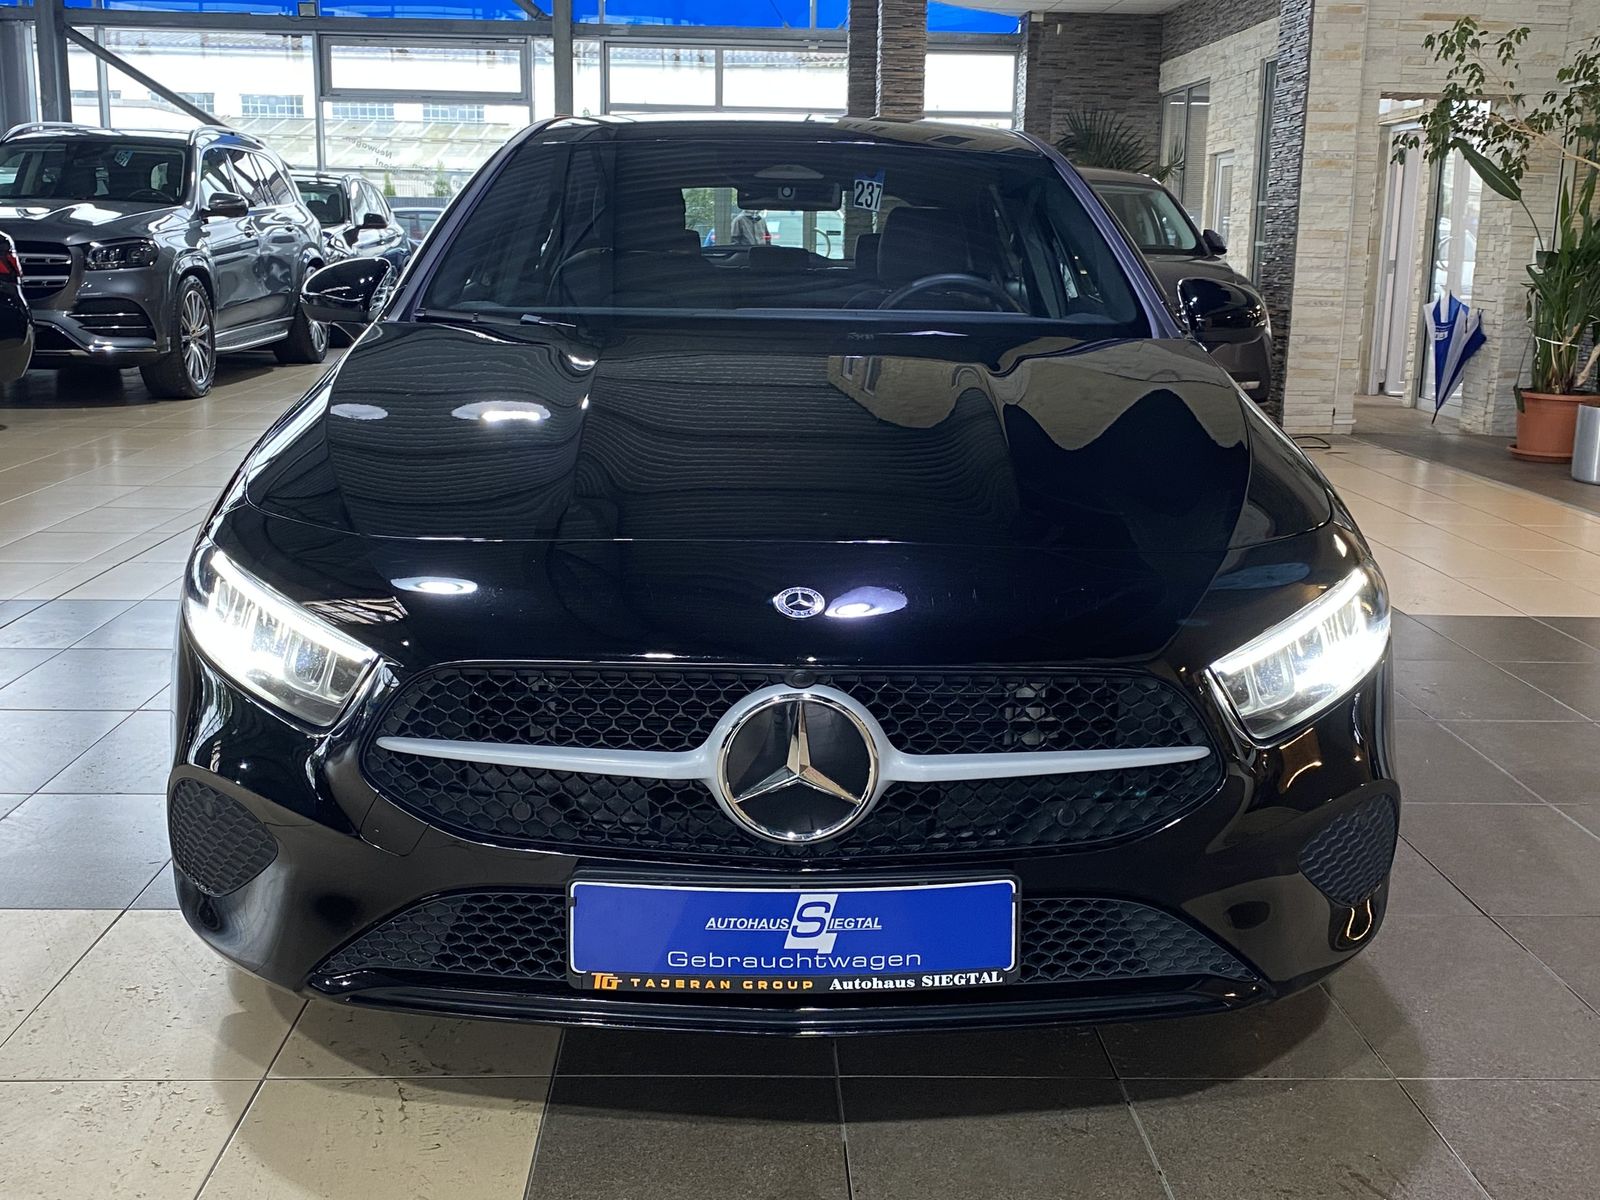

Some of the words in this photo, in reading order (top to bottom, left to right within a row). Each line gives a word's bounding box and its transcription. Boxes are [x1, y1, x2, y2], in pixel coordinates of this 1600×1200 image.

[854, 181, 882, 210] 237
[705, 917, 790, 930] AUTOHAUS
[667, 951, 921, 970] Gebrauchtwagen
[742, 980, 814, 990] GROUP
[829, 978, 915, 991] Autohaus
[921, 971, 1003, 988] SIEGTAL
